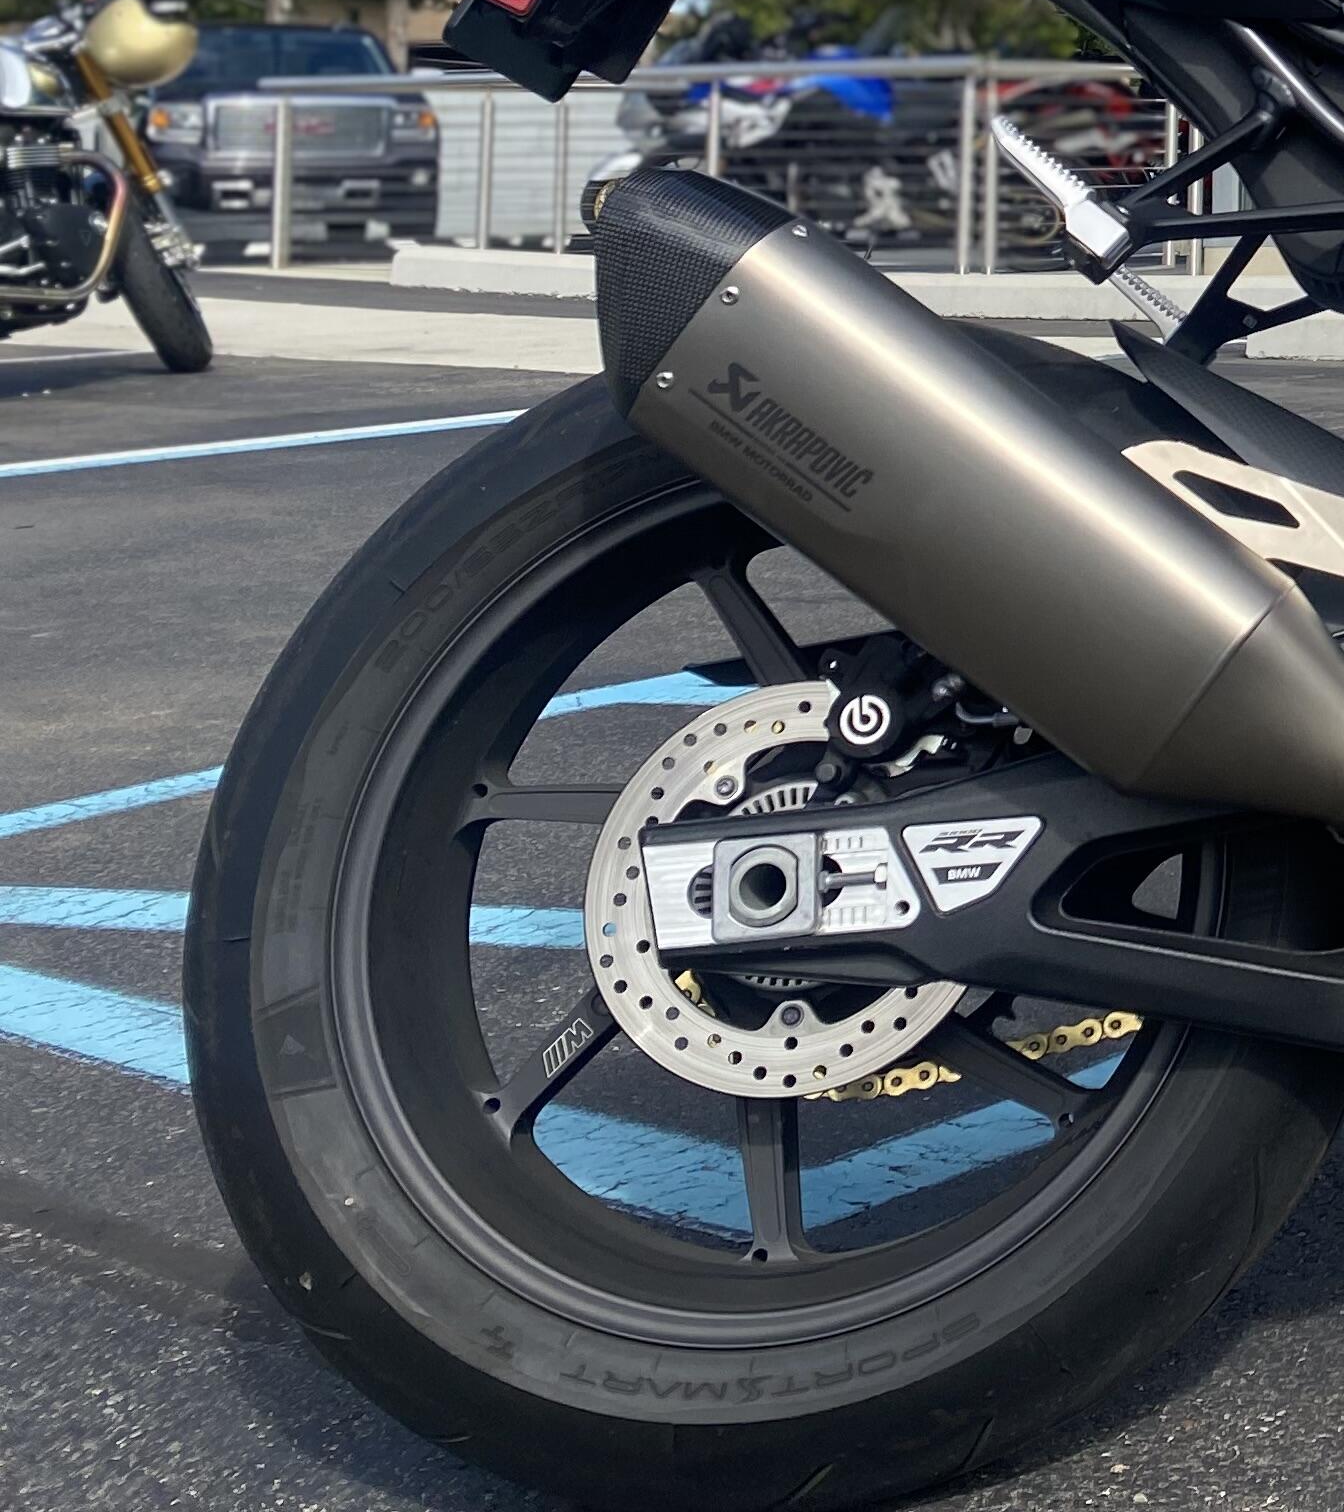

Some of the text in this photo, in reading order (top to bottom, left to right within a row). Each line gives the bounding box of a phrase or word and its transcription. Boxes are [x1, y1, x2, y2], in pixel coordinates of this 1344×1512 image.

[709, 419, 814, 502] BMW MOTORRAD
[919, 830, 1025, 854] RR
[947, 867, 981, 881] BMW
